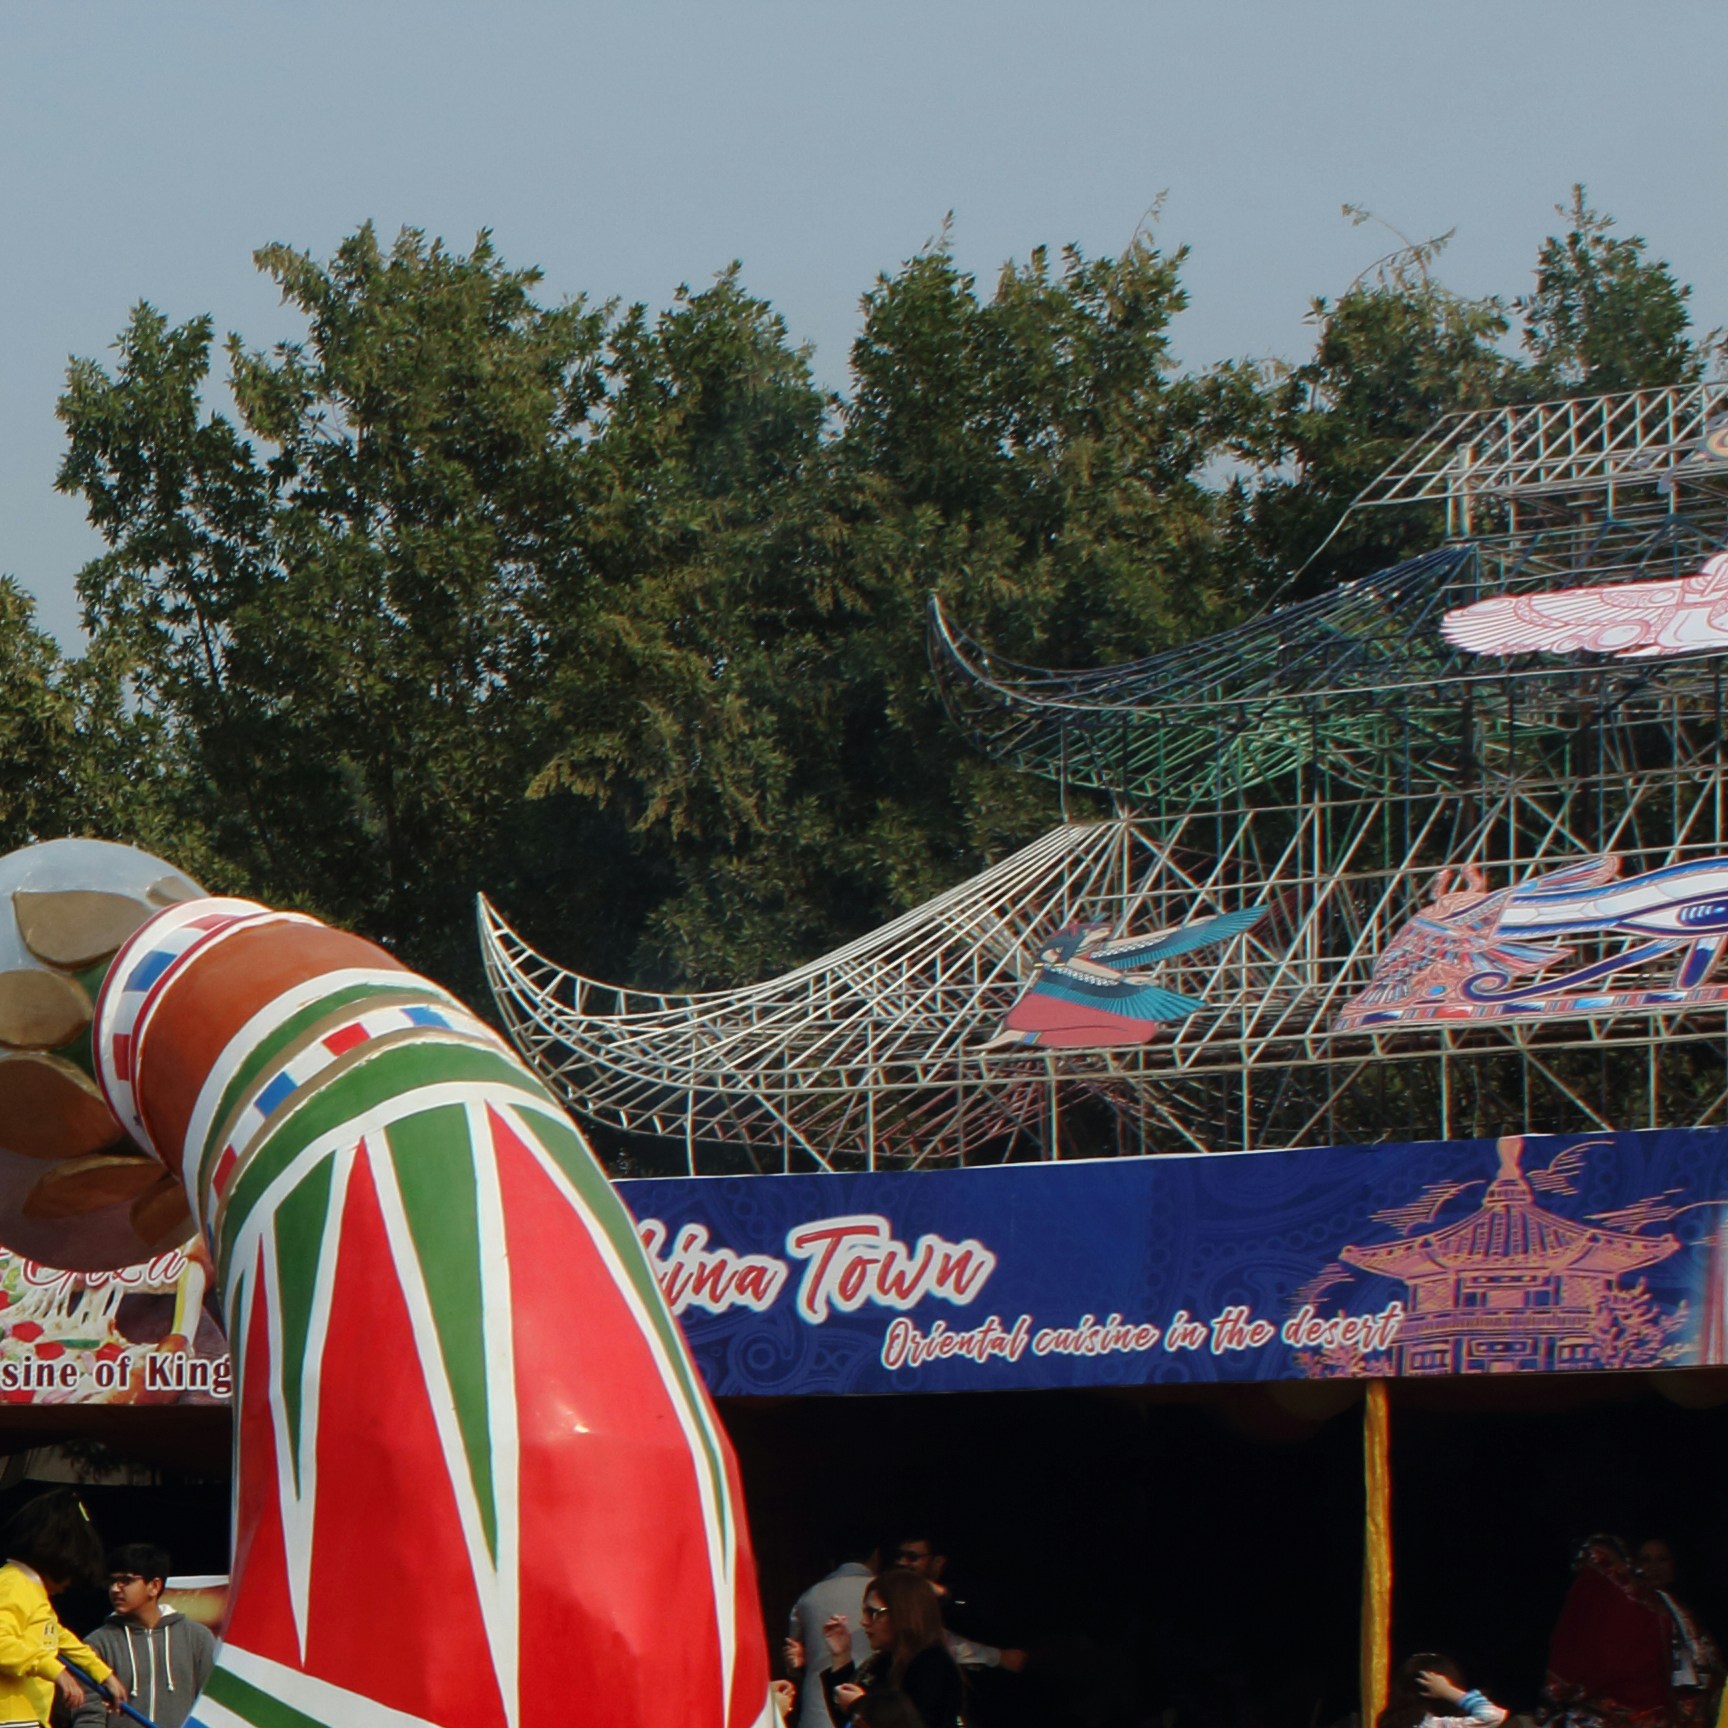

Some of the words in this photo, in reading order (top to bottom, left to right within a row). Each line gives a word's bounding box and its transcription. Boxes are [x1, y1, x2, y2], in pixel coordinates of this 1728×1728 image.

[639, 1219, 788, 1312] ina
[788, 1216, 994, 1324] Town
[883, 1316, 1033, 1370] Oriental
[1032, 1314, 1159, 1356] cuisine
[1164, 1309, 1206, 1352] in
[1211, 1305, 1275, 1354] the
[1284, 1301, 1403, 1351] desert
[94, 1353, 132, 1391] of
